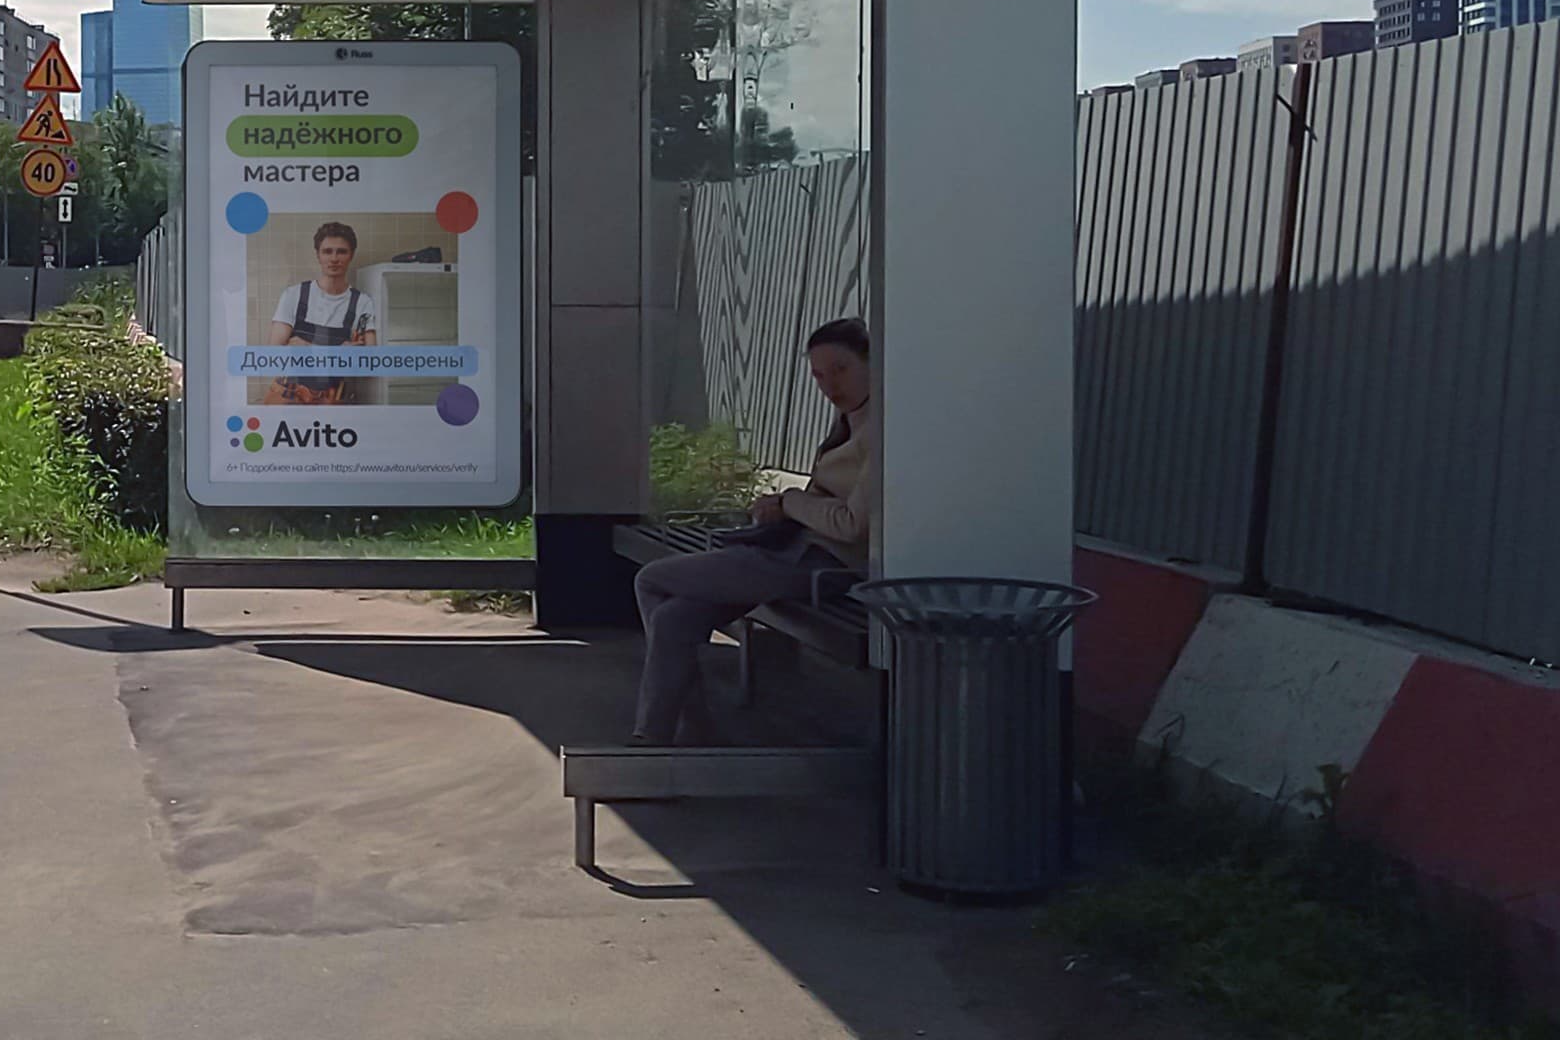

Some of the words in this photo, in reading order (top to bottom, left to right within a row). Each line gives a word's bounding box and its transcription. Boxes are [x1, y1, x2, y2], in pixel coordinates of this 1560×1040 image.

[244, 83, 369, 112] Найдите
[244, 122, 402, 150] надёжного
[32, 162, 55, 183] 40
[244, 163, 360, 187] мастера
[240, 351, 352, 371] Документы
[358, 354, 464, 371] проверены
[272, 421, 358, 448] Avito
[240, 462, 290, 474] Подробнее
[305, 464, 329, 472] сайте
